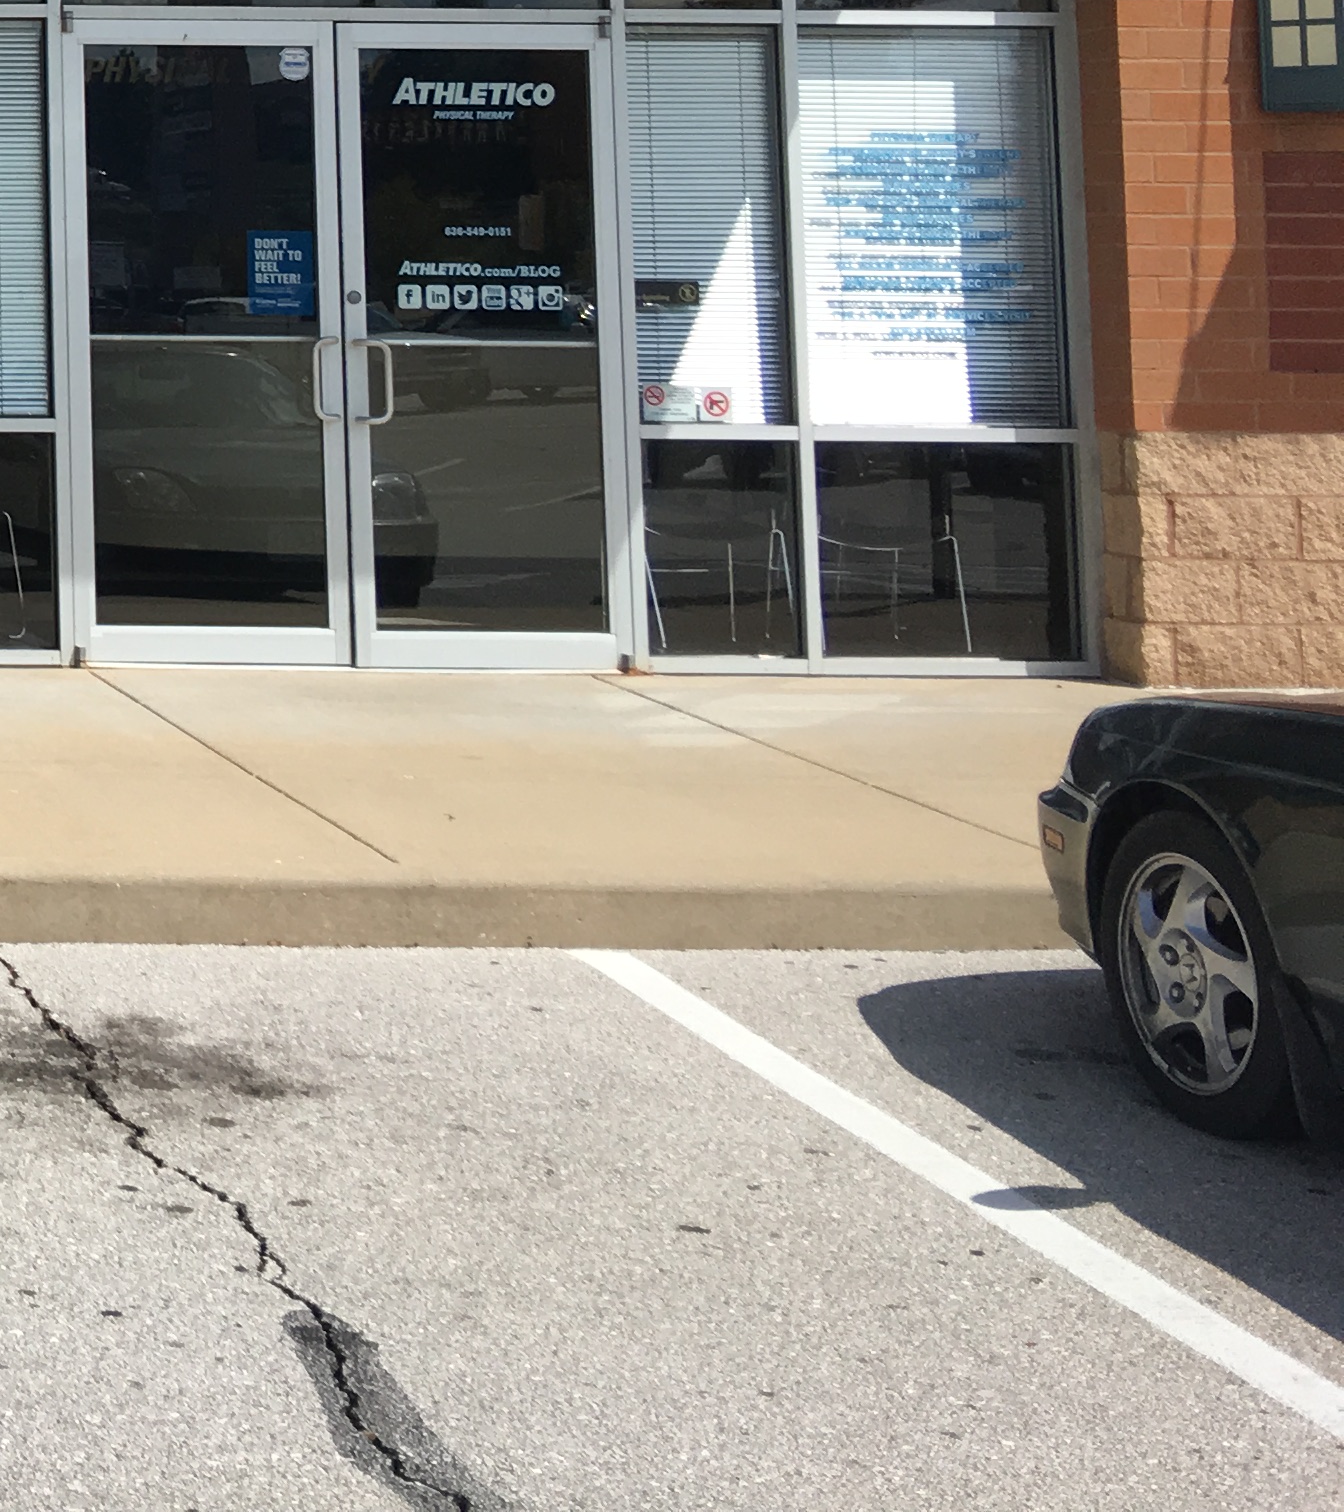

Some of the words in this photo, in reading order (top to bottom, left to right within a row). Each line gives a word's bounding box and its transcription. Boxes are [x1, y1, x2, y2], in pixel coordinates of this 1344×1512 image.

[392, 77, 555, 106] ATHLETICO
[433, 110, 474, 120] PHYSICAL
[476, 110, 514, 120] THERAPY
[254, 238, 289, 249] DON'T
[254, 250, 285, 261] WAIT
[287, 250, 303, 262] TO
[255, 261, 279, 272] FEEL
[255, 273, 301, 285] BETTER!
